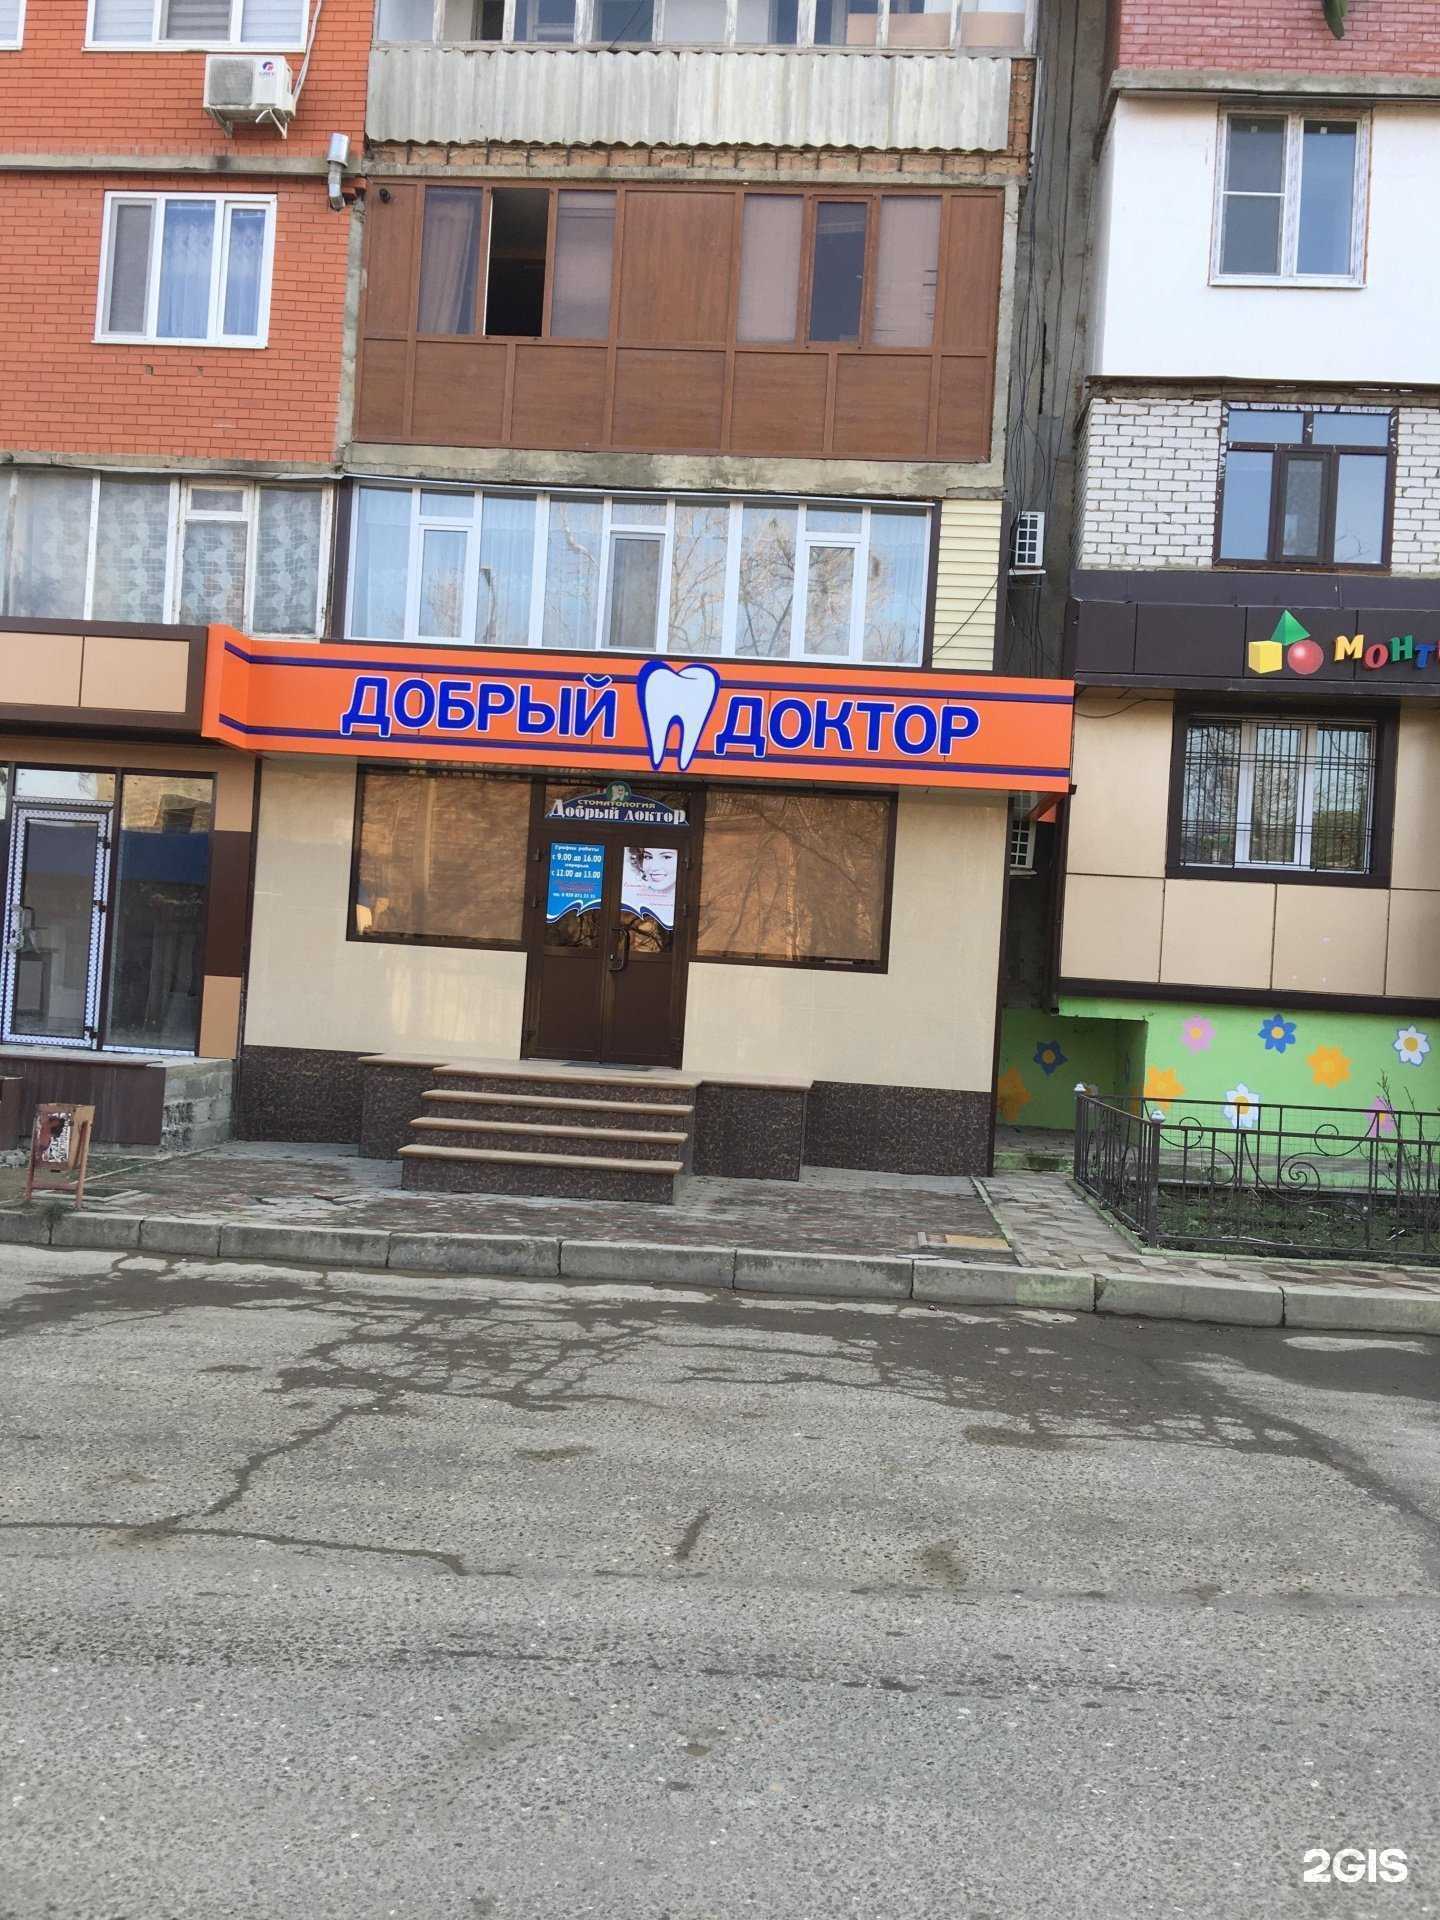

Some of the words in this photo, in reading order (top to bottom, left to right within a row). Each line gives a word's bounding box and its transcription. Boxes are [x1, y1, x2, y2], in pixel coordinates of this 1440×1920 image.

[1333, 633, 1440, 669] МОНТ
[340, 674, 617, 738] ДОБРЫЙ
[714, 695, 981, 758] ДОКТОР
[549, 799, 620, 820] Добрый
[556, 853, 572, 861] 9.00
[583, 854, 602, 863] 16.00
